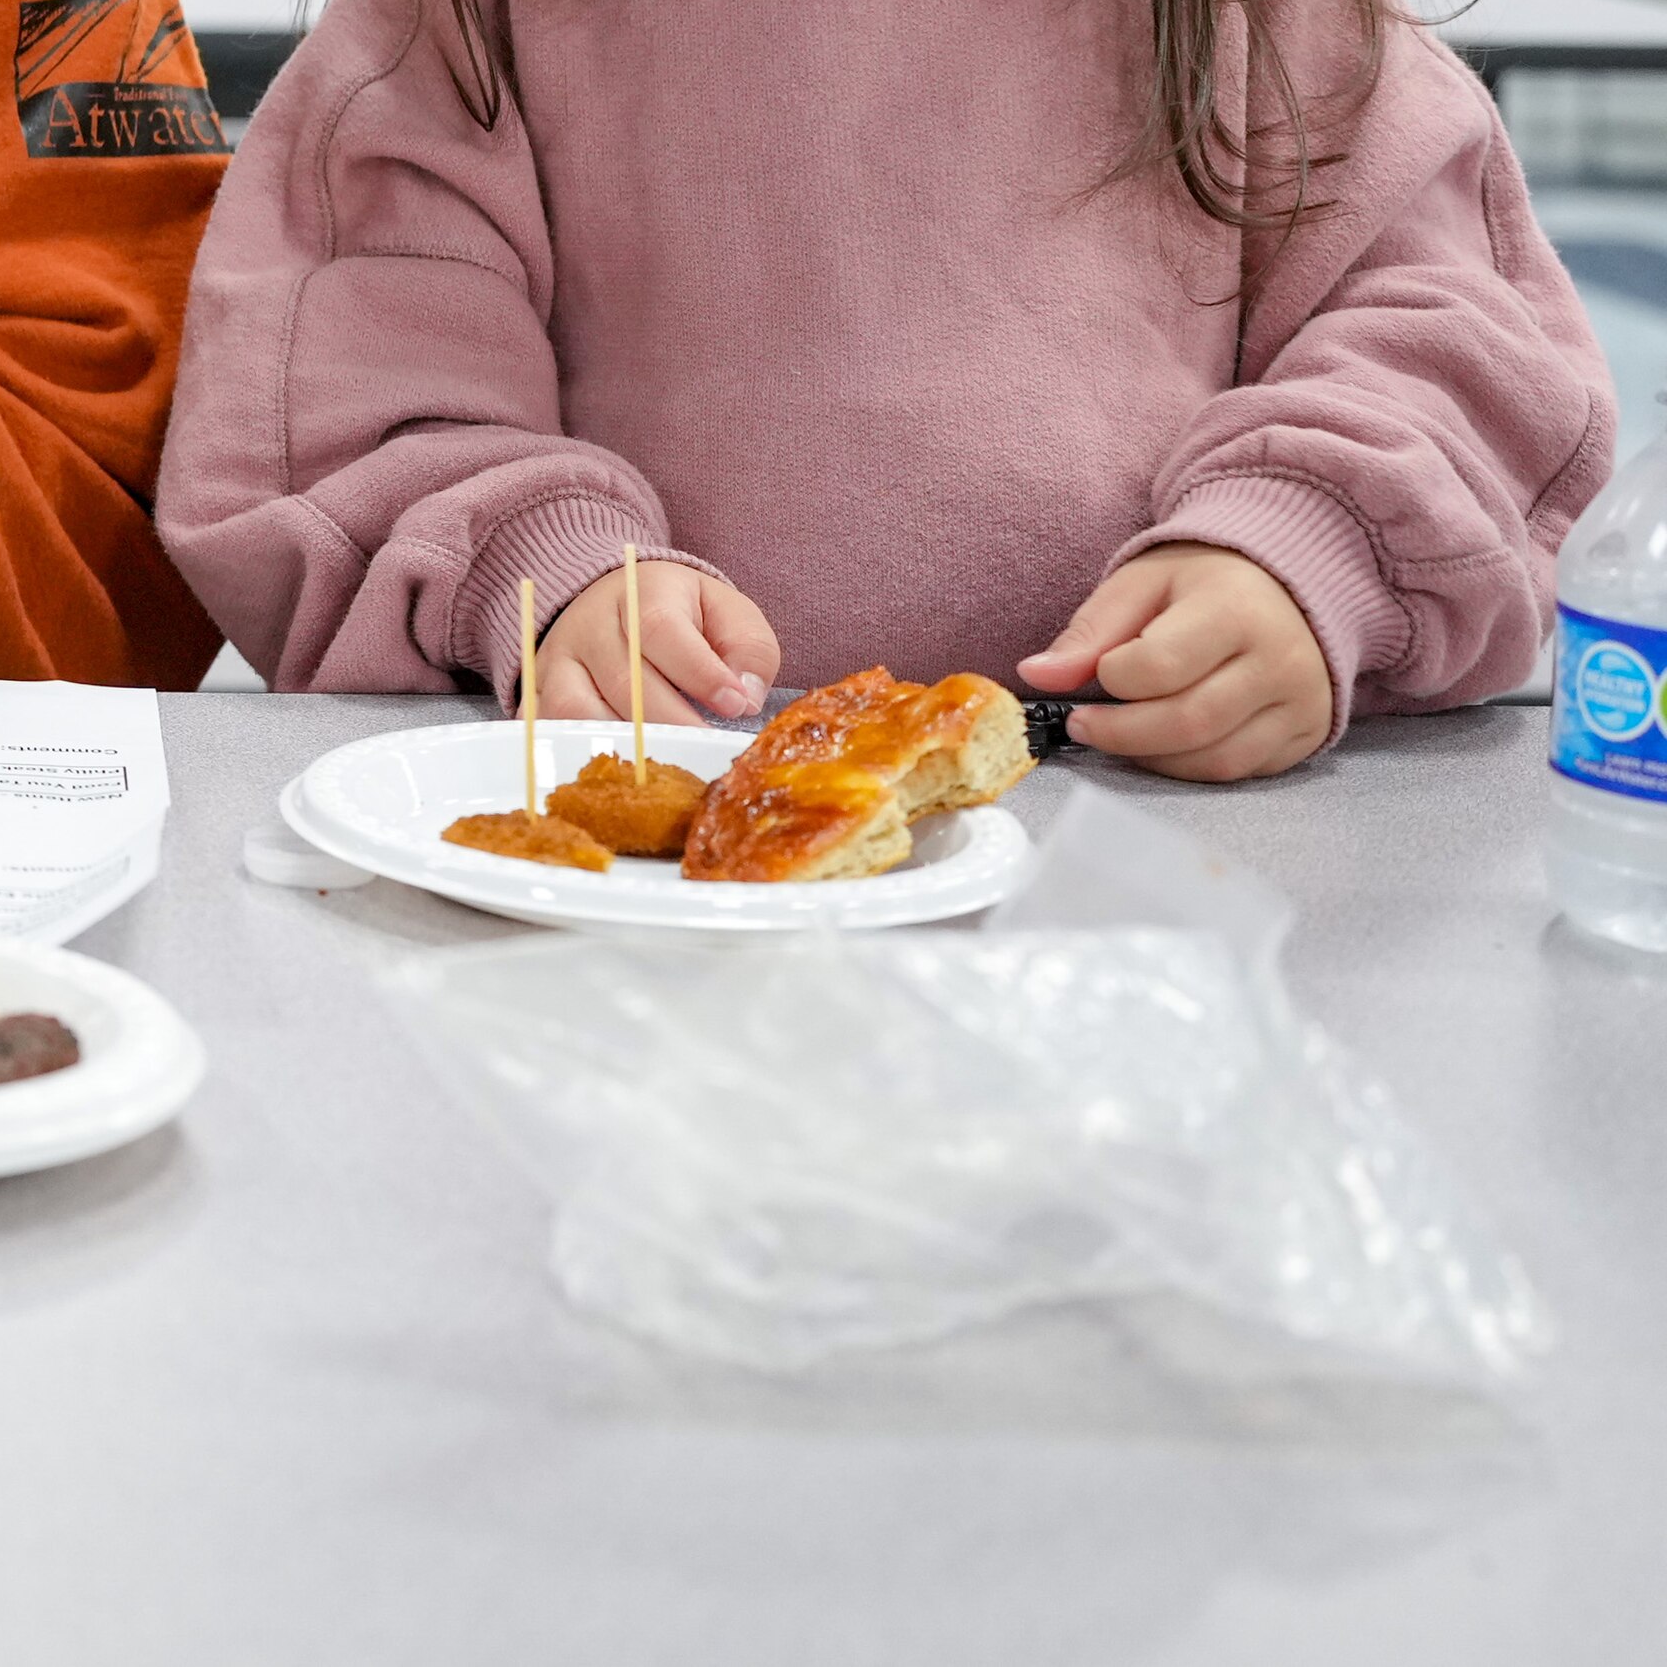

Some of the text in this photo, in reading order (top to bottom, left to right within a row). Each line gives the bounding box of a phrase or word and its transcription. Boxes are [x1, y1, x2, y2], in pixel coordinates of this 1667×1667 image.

[1, 745, 118, 755] Comments:
[2, 765, 57, 773] Steak
[28, 781, 64, 789] You
[72, 781, 120, 789] Food
[14, 793, 71, 802] Items
[78, 793, 122, 801] New
